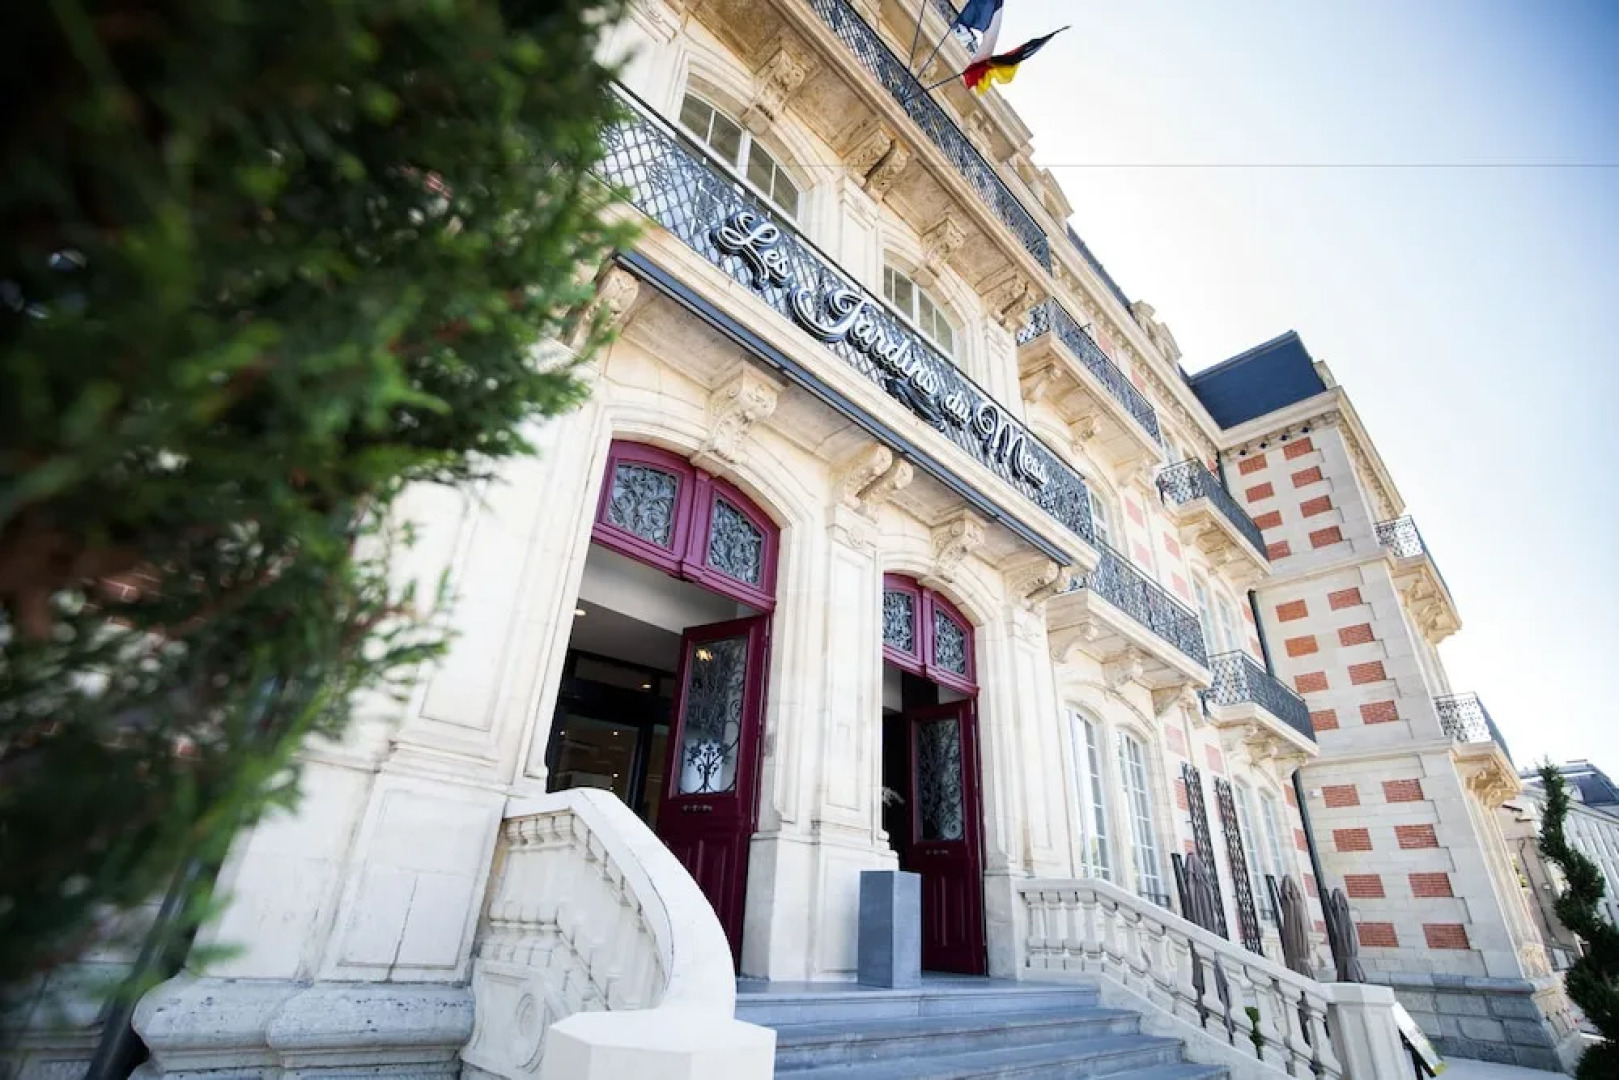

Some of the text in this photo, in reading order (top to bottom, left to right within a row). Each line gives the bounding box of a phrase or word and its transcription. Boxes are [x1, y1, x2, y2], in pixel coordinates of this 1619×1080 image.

[714, 211, 793, 283] Les
[796, 287, 939, 394] Jardins
[943, 390, 972, 424] du
